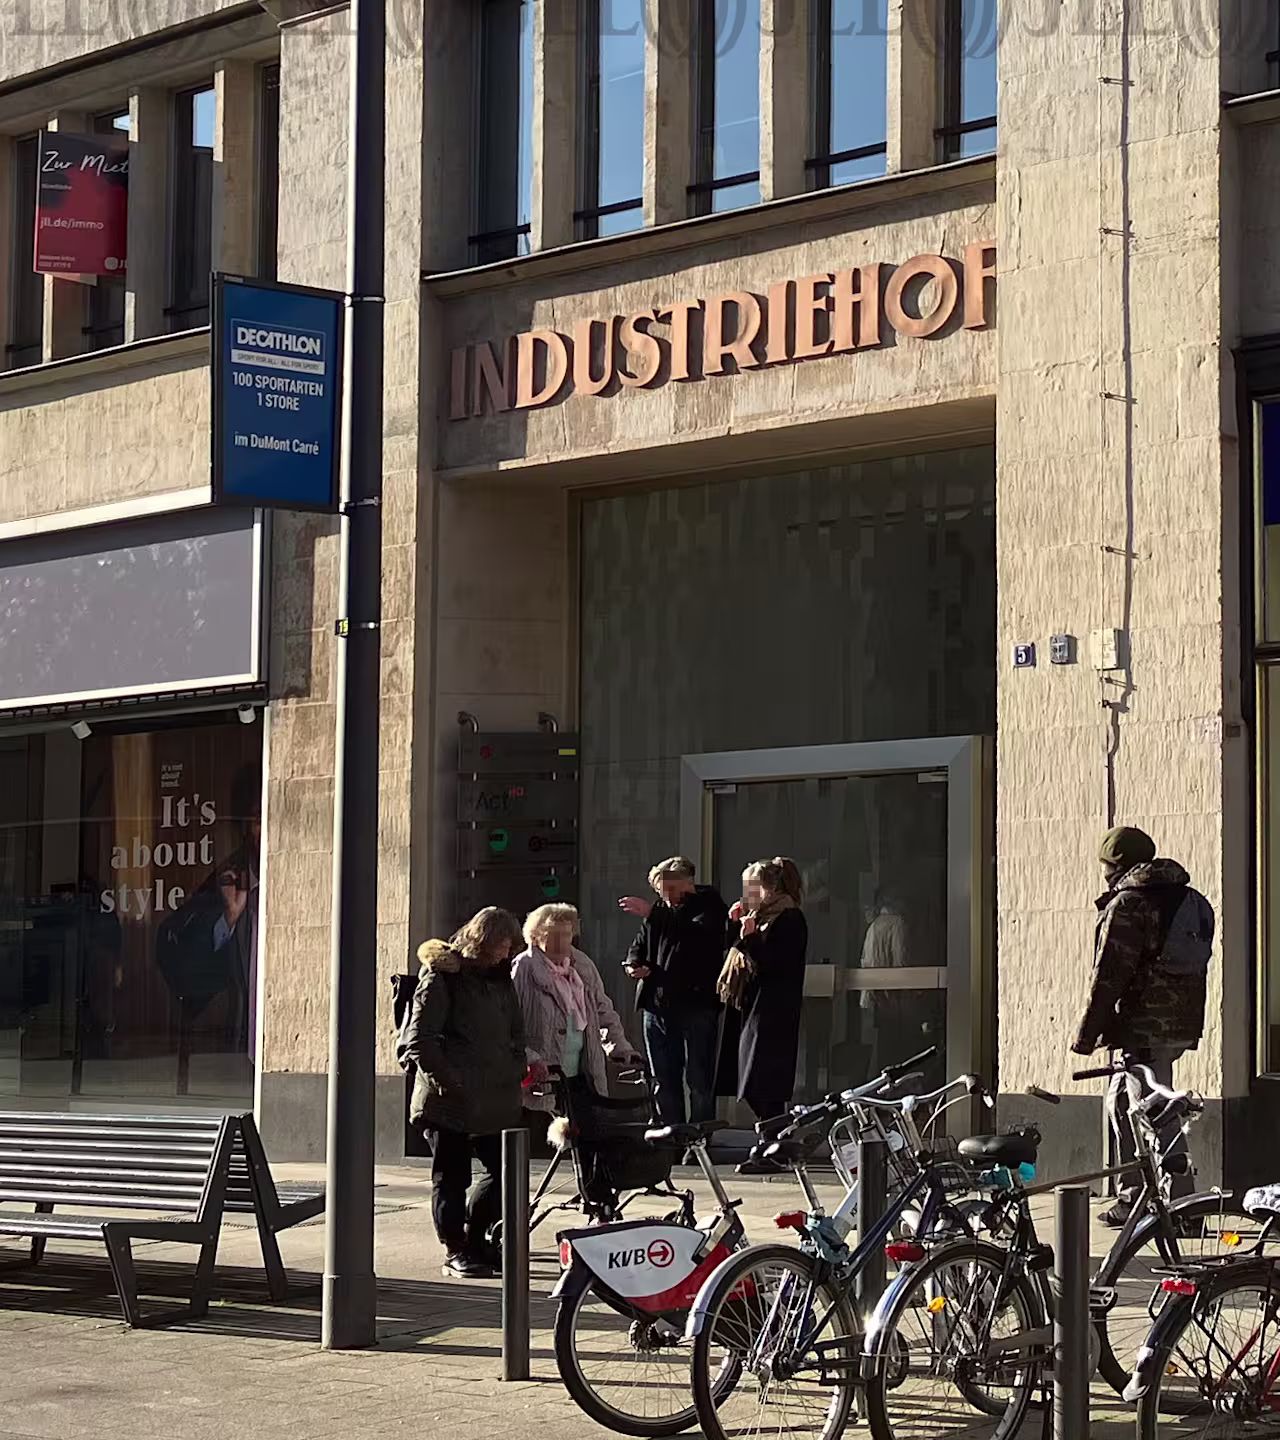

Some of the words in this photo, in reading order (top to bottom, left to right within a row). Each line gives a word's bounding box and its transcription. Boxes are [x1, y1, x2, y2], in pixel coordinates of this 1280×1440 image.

[41, 150, 73, 172] Zur
[39, 216, 104, 230] jll.de/immo
[237, 326, 321, 356] DECATHLON
[449, 239, 997, 421] INDUSTRIEHOF
[232, 371, 253, 388] 100
[255, 374, 324, 397] SPORTARTEN
[257, 392, 263, 407] 1
[265, 394, 300, 411] STORE
[234, 431, 249, 447] im
[250, 433, 290, 453] DuMont
[292, 439, 319, 456] Carré
[1017, 646, 1026, 663] 5
[160, 793, 216, 828] It's
[110, 833, 214, 870] about
[608, 1247, 646, 1270] KVB
